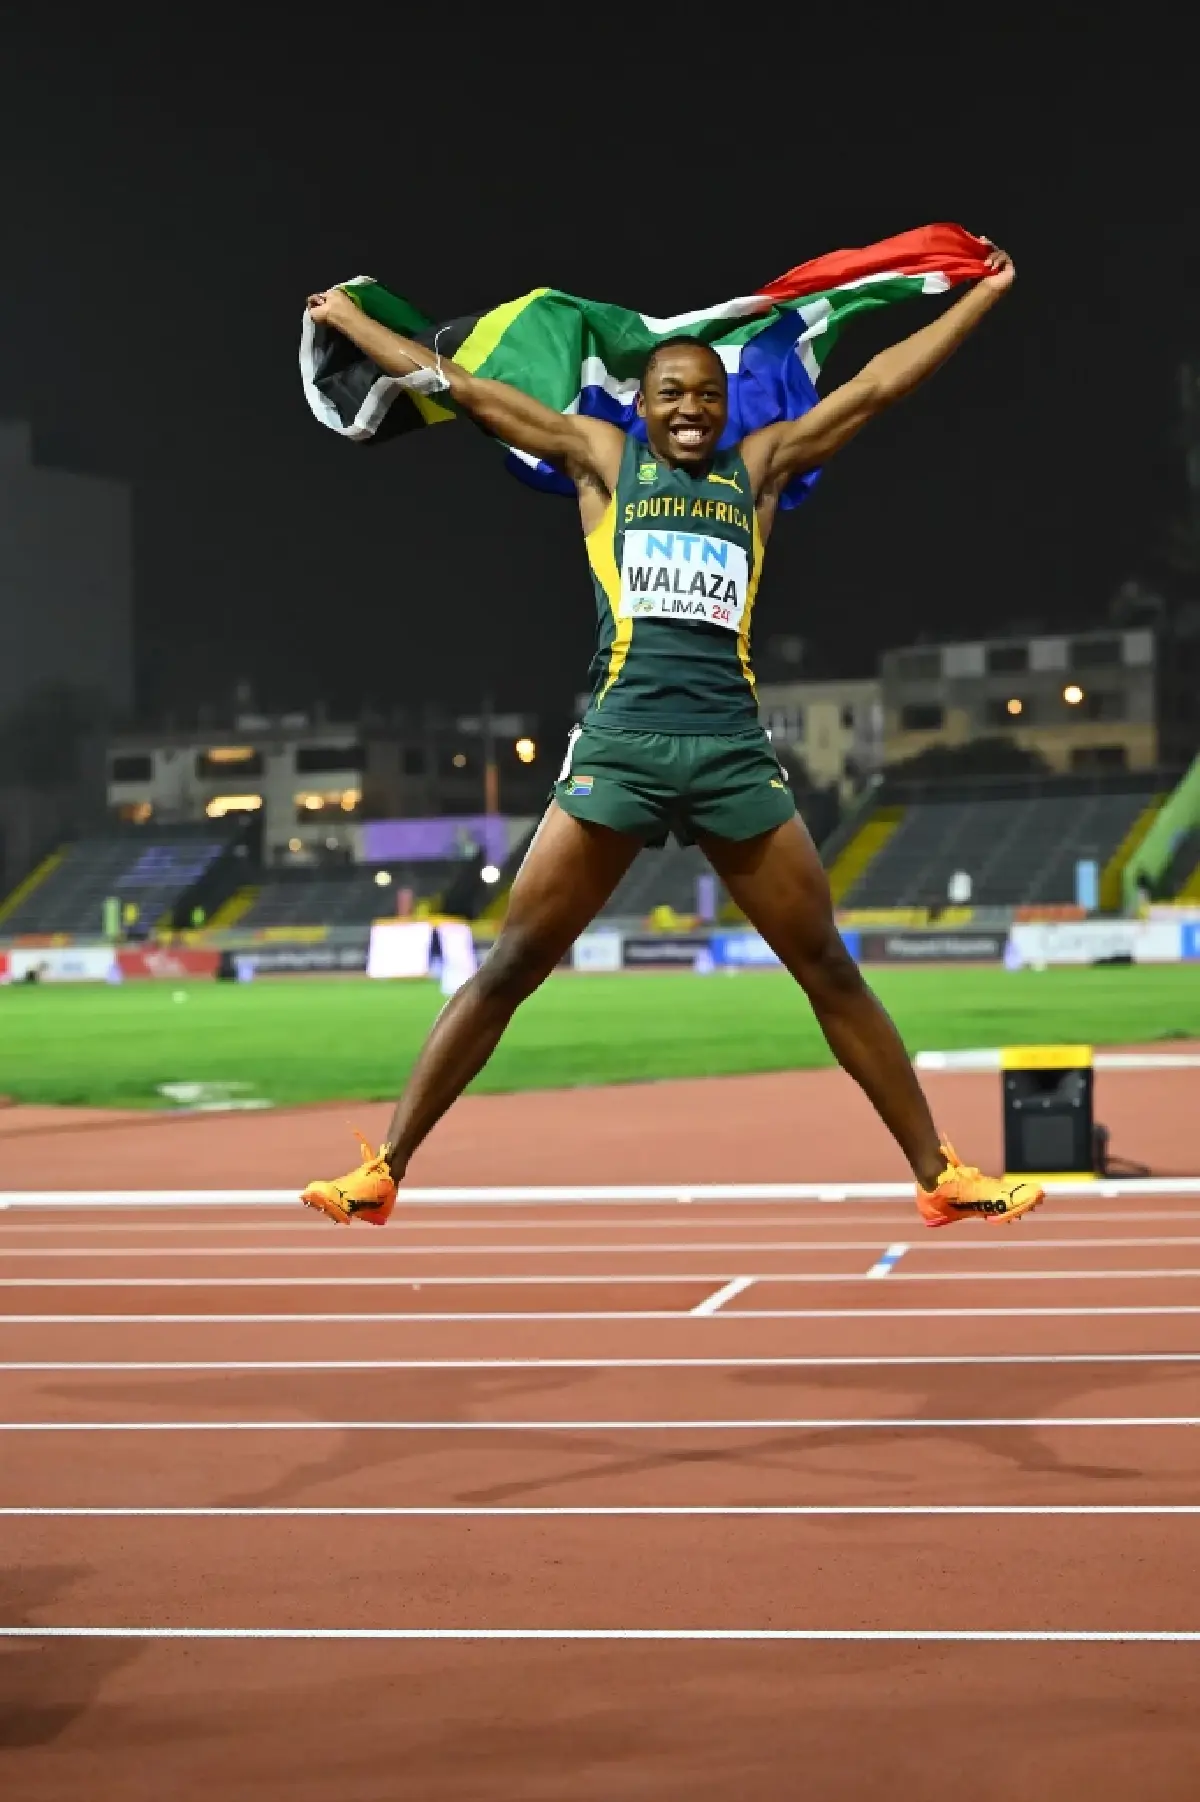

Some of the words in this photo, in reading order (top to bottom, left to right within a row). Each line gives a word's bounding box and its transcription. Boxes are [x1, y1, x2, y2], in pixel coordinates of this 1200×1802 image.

[625, 497, 684, 523] SOUTH
[645, 532, 728, 569] NTN
[627, 566, 737, 607] WALAZA
[661, 598, 706, 616] LIMA
[712, 605, 730, 623] 24
